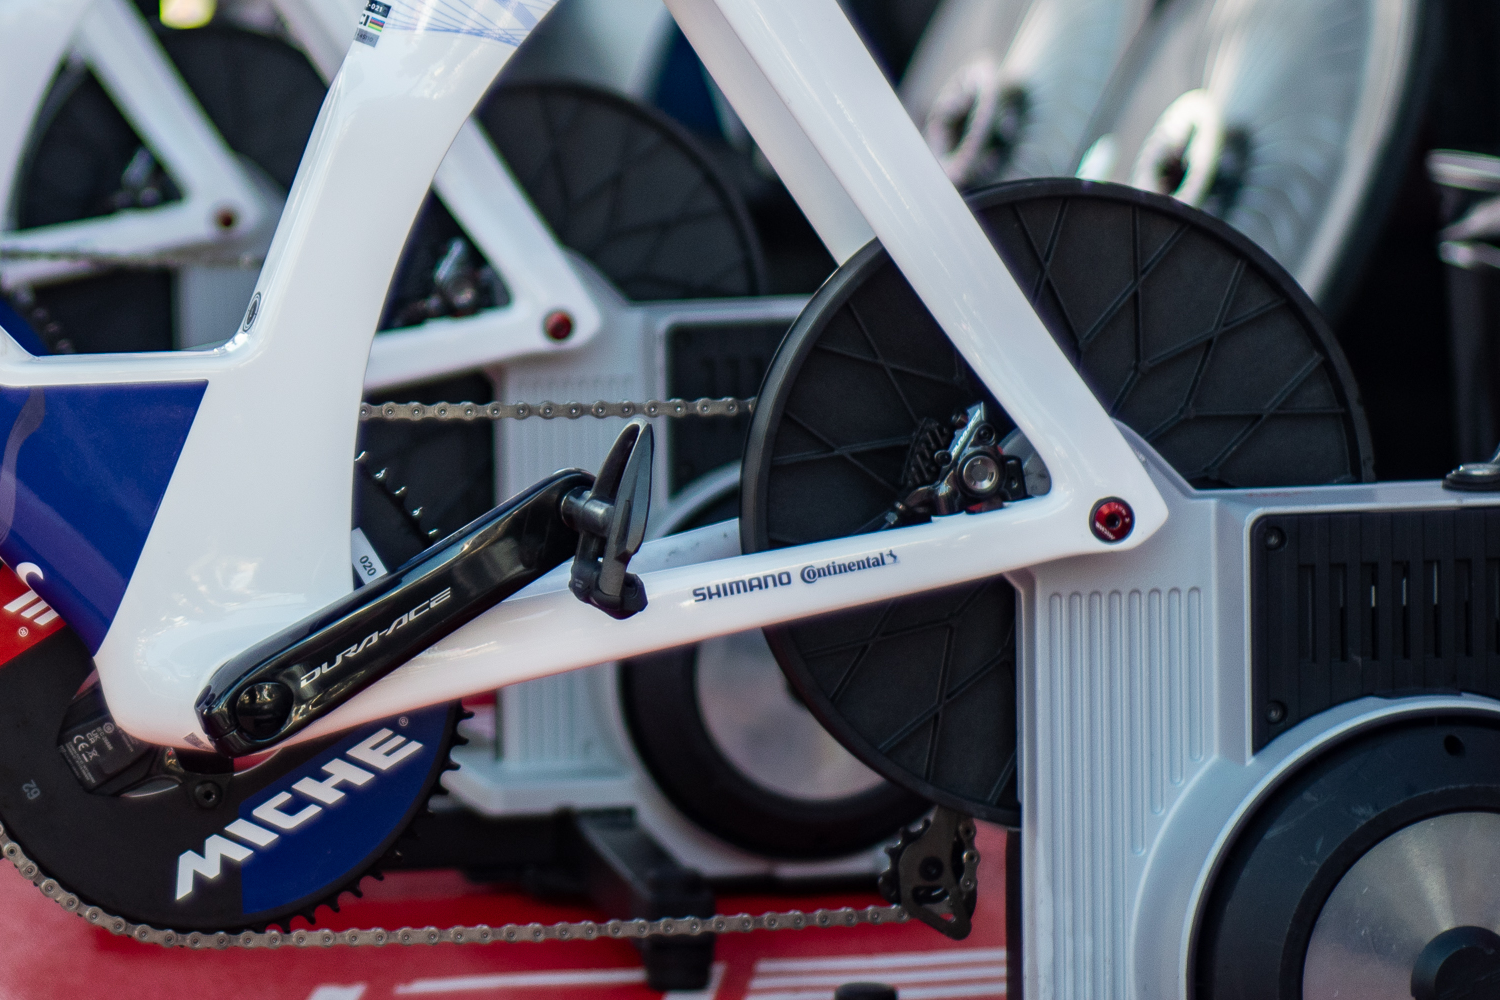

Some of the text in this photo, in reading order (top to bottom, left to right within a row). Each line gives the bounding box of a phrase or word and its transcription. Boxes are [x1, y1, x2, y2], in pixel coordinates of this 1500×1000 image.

[359, 555, 377, 577] 020
[692, 551, 886, 603] SHIMANO Continental
[300, 586, 451, 689] DURA-ACE
[175, 727, 425, 901] MICHE
